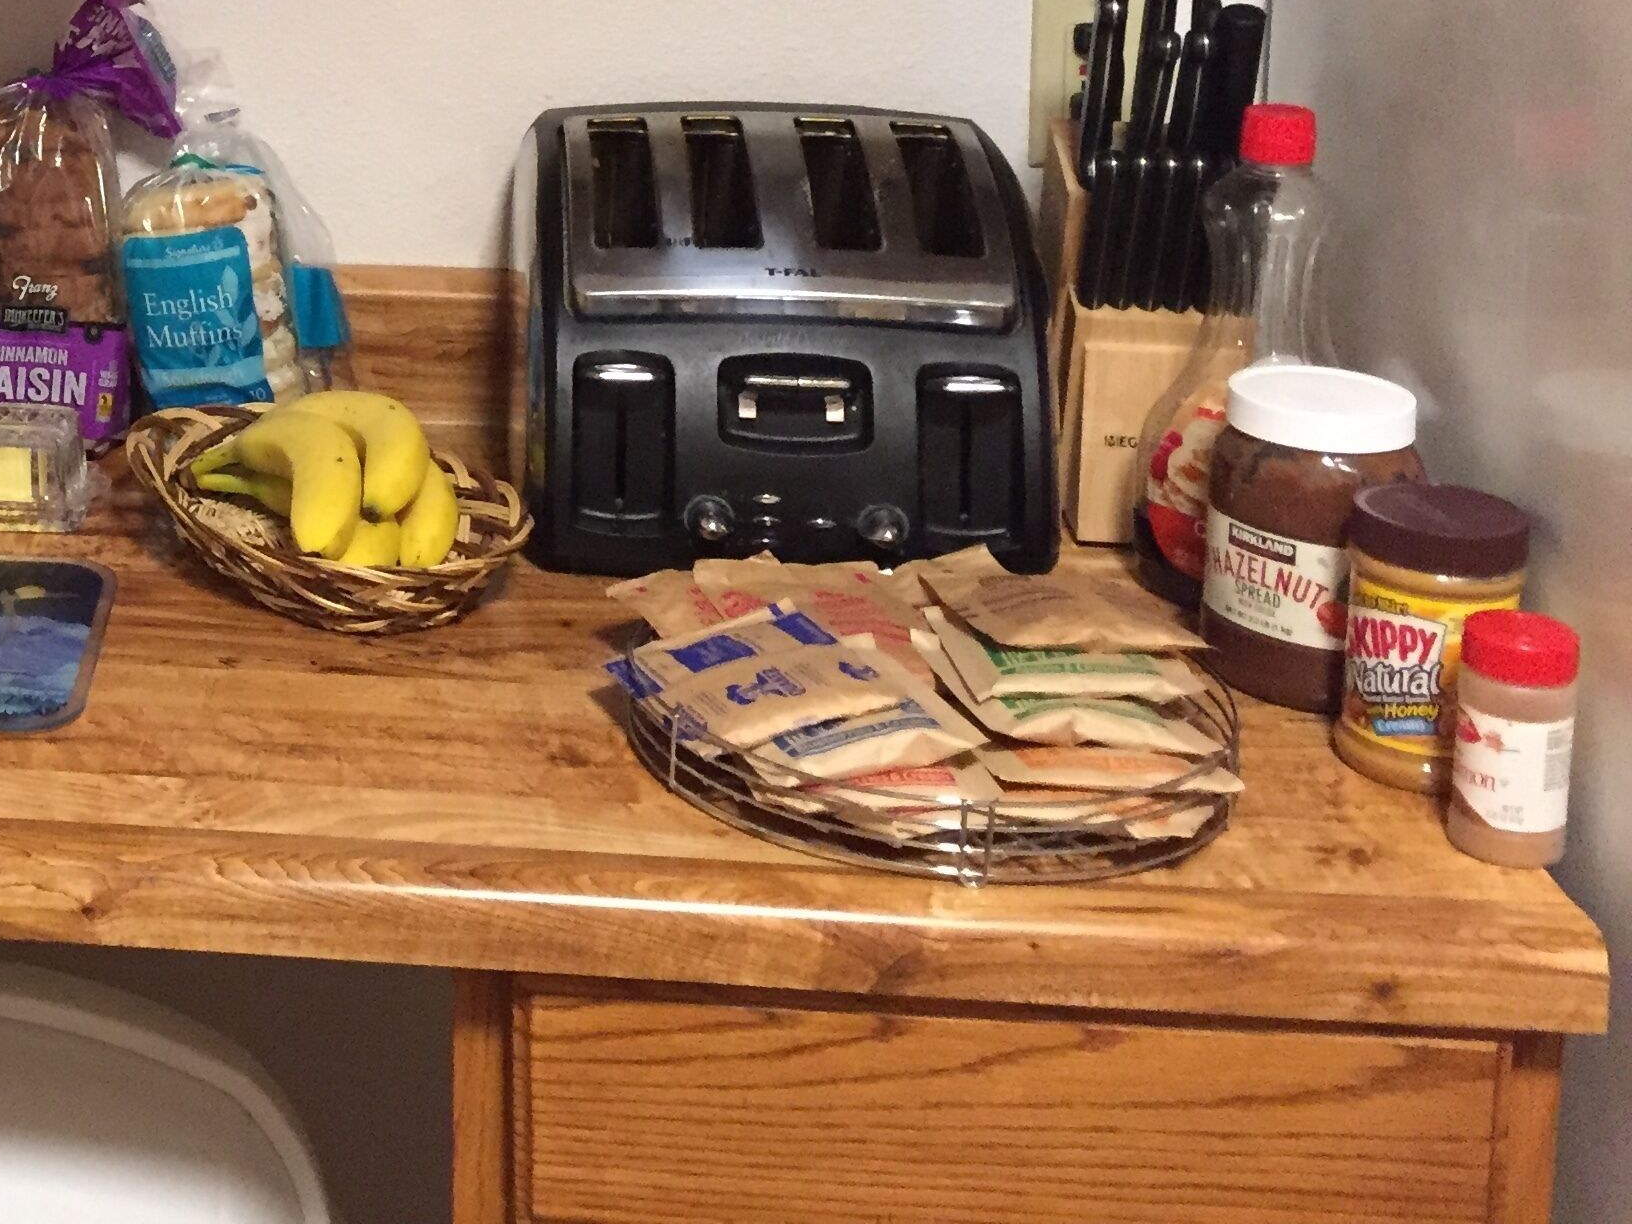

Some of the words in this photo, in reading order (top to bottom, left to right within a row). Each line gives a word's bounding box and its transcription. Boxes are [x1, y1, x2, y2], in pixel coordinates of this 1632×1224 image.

[12, 275, 59, 302] Franz
[143, 285, 234, 320] English
[147, 323, 243, 349] Muffins
[1231, 526, 1295, 557] KIRKLAND
[1208, 546, 1329, 610] HAZELNUT
[1234, 579, 1281, 609] SPREAD
[1346, 662, 1441, 696] Natural
[1384, 703, 1440, 722] Honey
